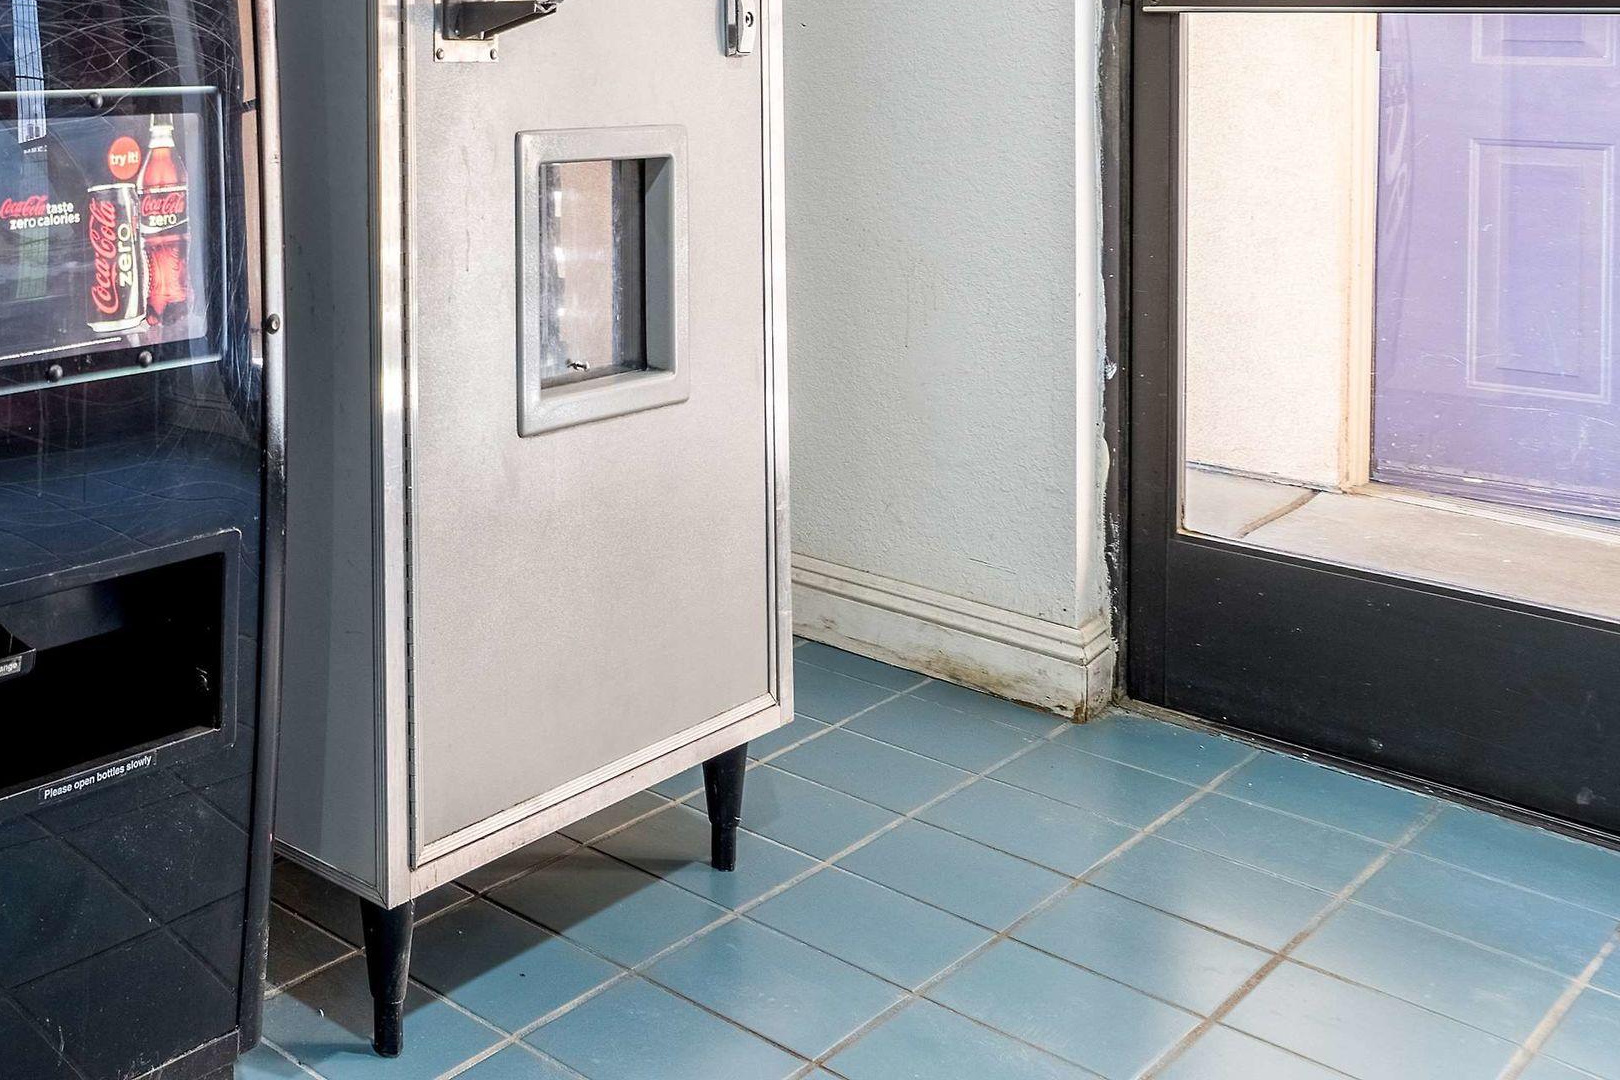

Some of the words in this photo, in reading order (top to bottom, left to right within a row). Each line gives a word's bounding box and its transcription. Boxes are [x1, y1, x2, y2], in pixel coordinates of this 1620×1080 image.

[110, 154, 127, 167] try
[0, 194, 49, 219] Coca-Cola
[46, 202, 74, 214] taste
[141, 192, 186, 216] Coca-Cola
[10, 217, 36, 230] zero
[37, 212, 80, 227] calories
[149, 214, 177, 227] zero
[89, 197, 120, 314] Coca-Cola
[118, 223, 132, 287] zero
[44, 785, 72, 800] Please
[74, 775, 95, 790] open
[96, 765, 125, 781] bottles
[126, 755, 152, 770] slowly
